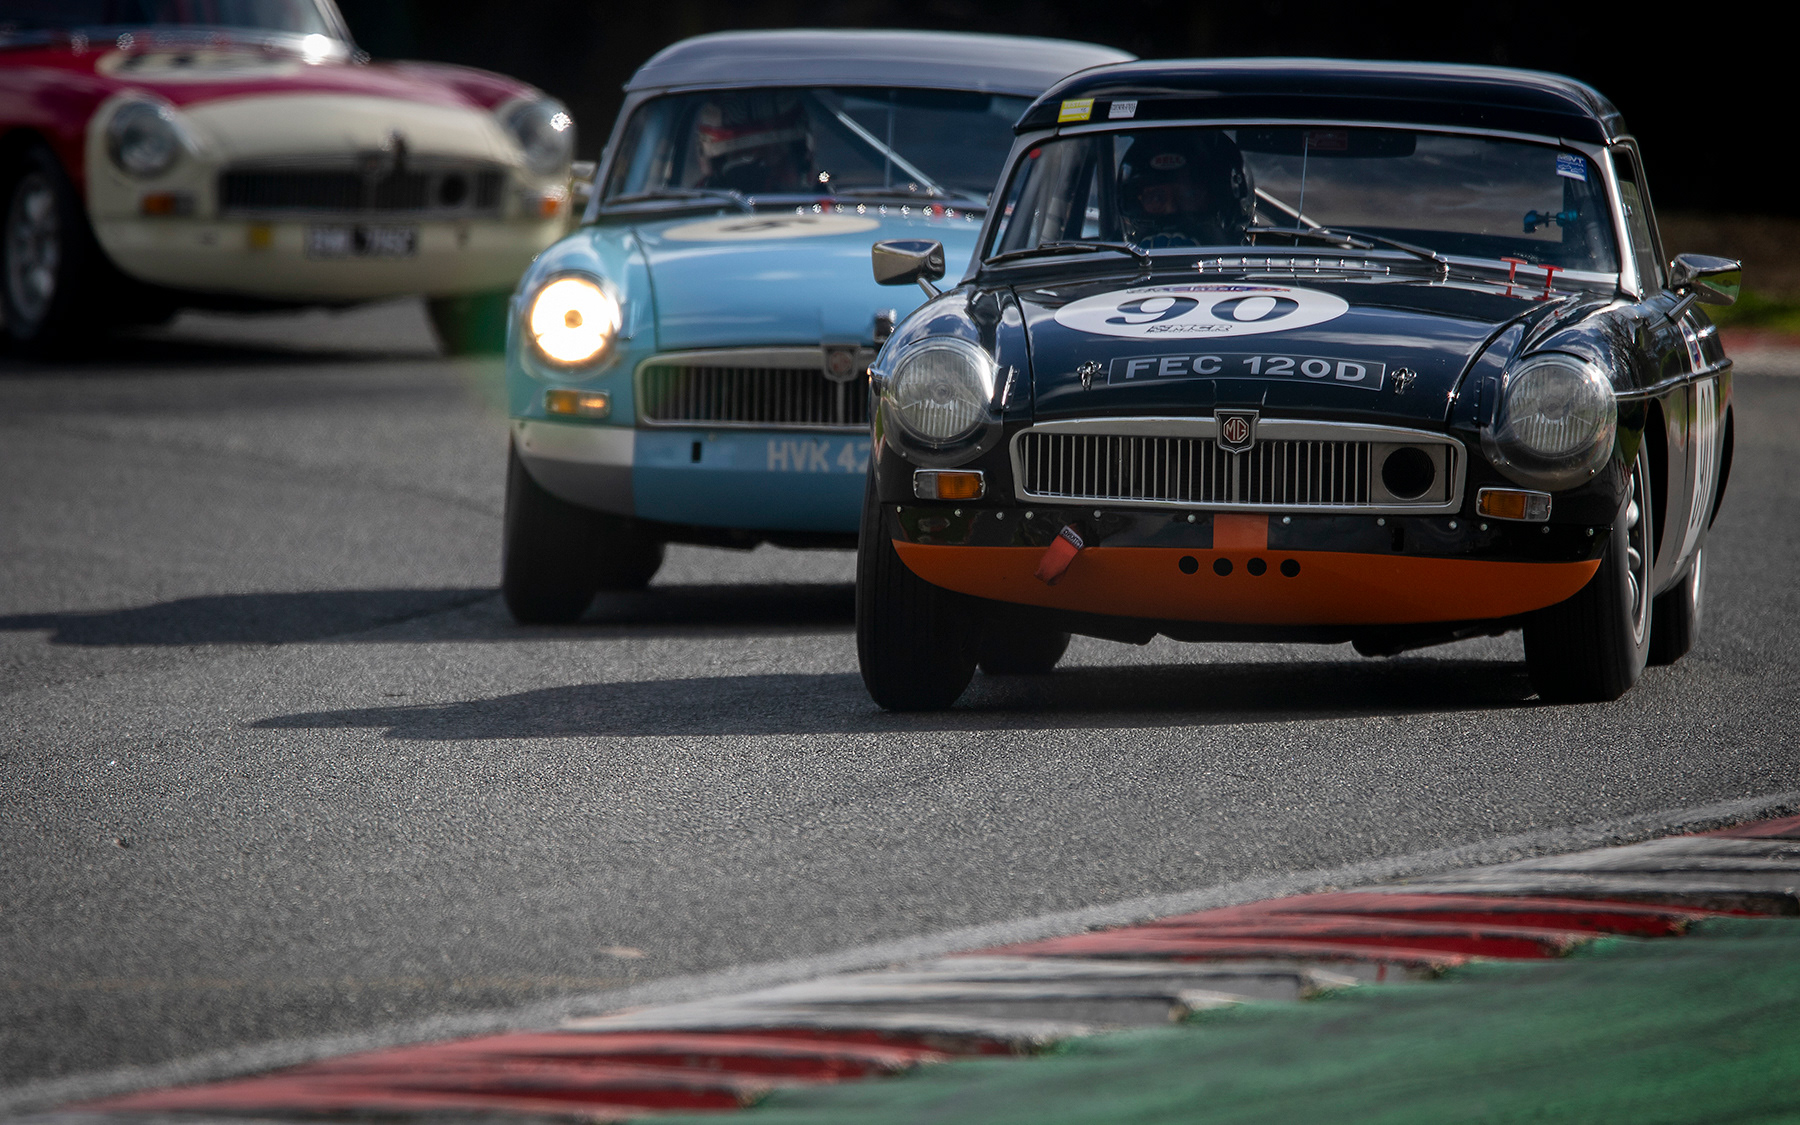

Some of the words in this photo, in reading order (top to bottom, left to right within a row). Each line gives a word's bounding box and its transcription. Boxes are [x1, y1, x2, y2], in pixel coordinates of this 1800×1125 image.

[1105, 296, 1300, 324] 90
[1125, 356, 1222, 379] FEC
[1243, 356, 1367, 382] 120D
[1225, 419, 1247, 441] MG
[767, 440, 830, 473] HVK
